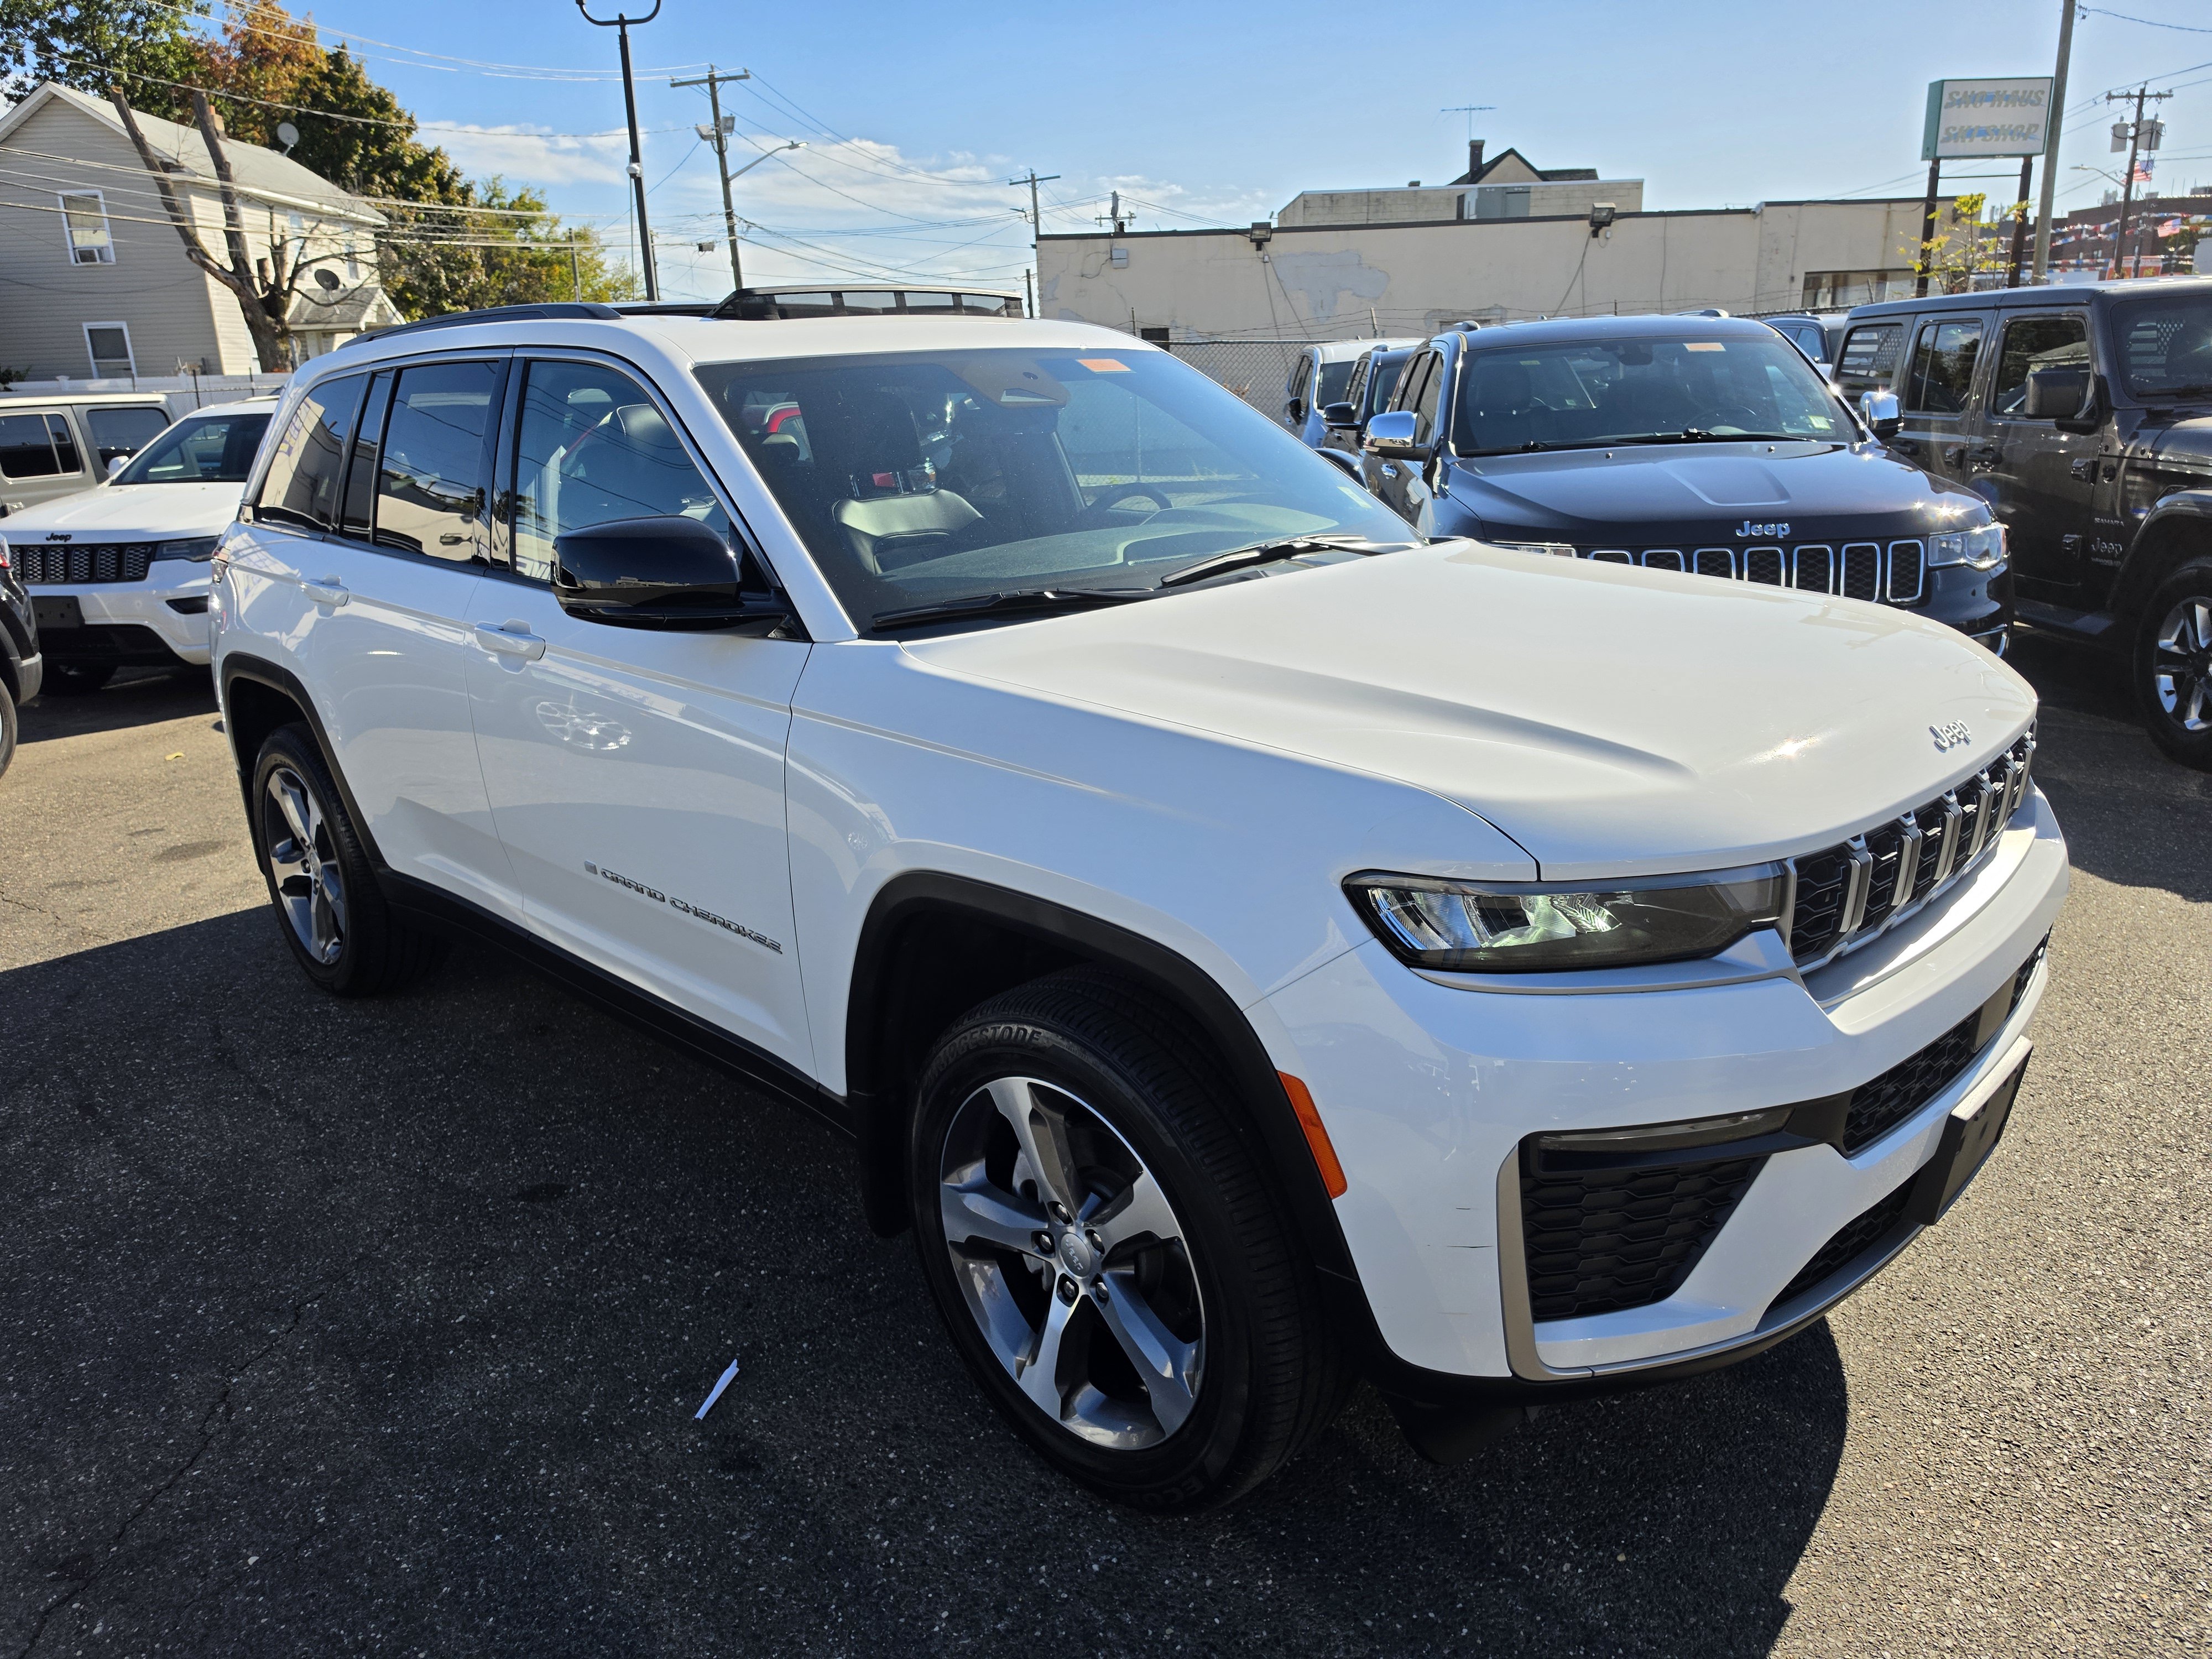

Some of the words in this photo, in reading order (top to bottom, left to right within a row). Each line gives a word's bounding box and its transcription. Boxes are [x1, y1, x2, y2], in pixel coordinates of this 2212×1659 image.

[1944, 90, 1987, 109] SNO
[1989, 89, 2045, 108] HAUS
[1939, 125, 1979, 144] SKI
[1980, 123, 2039, 142] SHOP
[45, 532, 72, 542] Jeep
[1735, 520, 1791, 539] Jeep
[2091, 537, 2122, 558] Jeep
[1929, 719, 1972, 751] Jeep
[600, 868, 665, 902] GRAND
[669, 897, 782, 954] CHEROKEE
